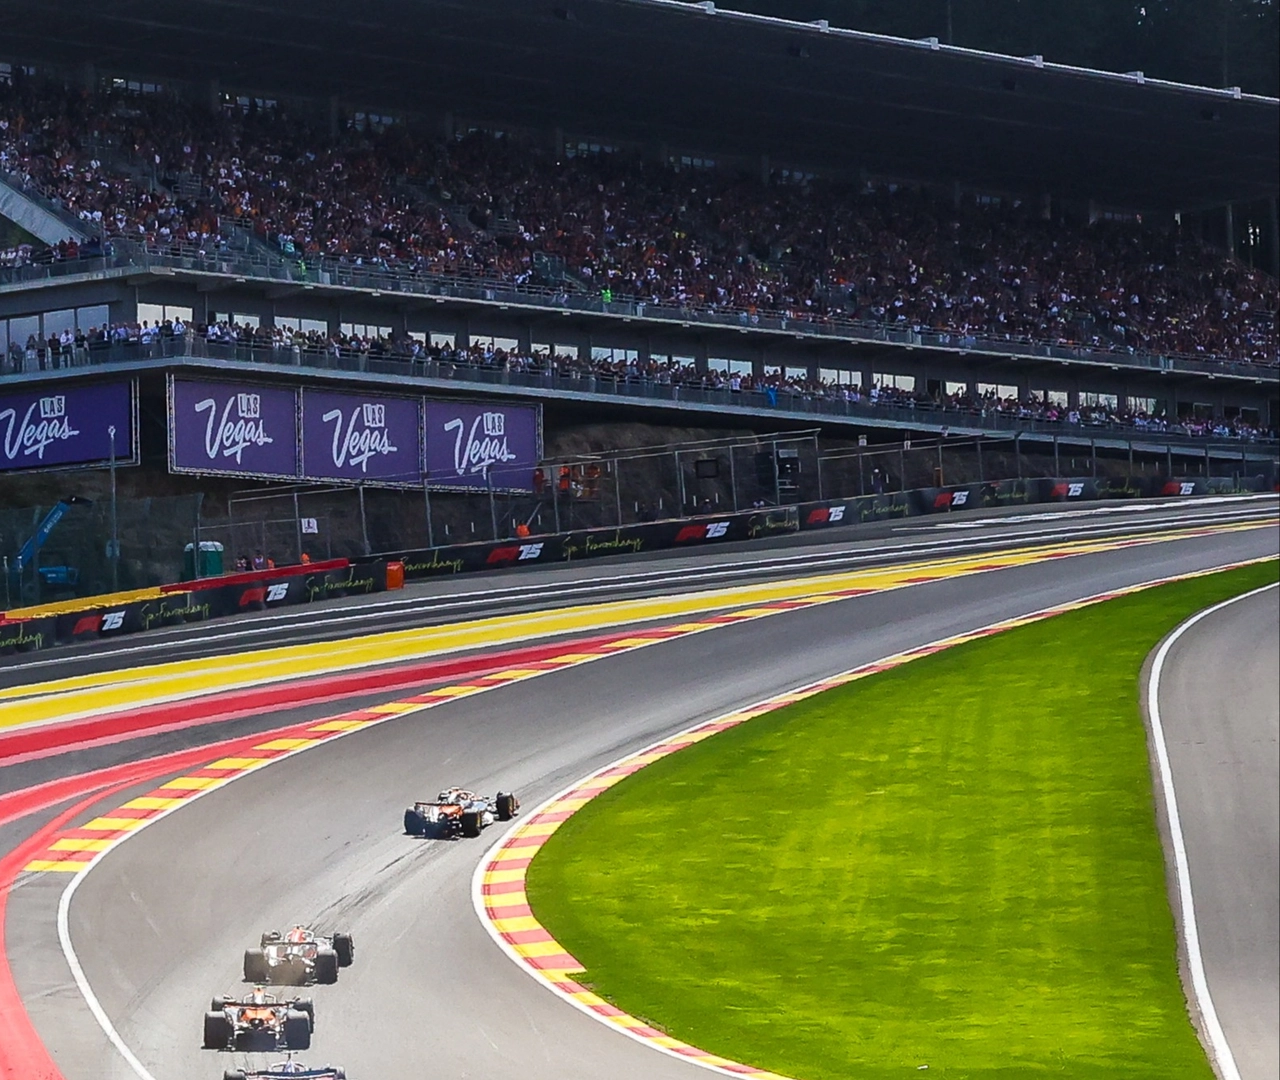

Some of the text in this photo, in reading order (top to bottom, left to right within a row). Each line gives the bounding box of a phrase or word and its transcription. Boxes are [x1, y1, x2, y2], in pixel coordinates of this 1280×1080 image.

[41, 396, 65, 418] LAS
[238, 394, 260, 418] LAS
[363, 404, 385, 427] LAS
[195, 397, 273, 464] Vegas
[483, 412, 505, 435] LAS
[323, 407, 397, 472] Vegas
[444, 416, 516, 479] Vegas
